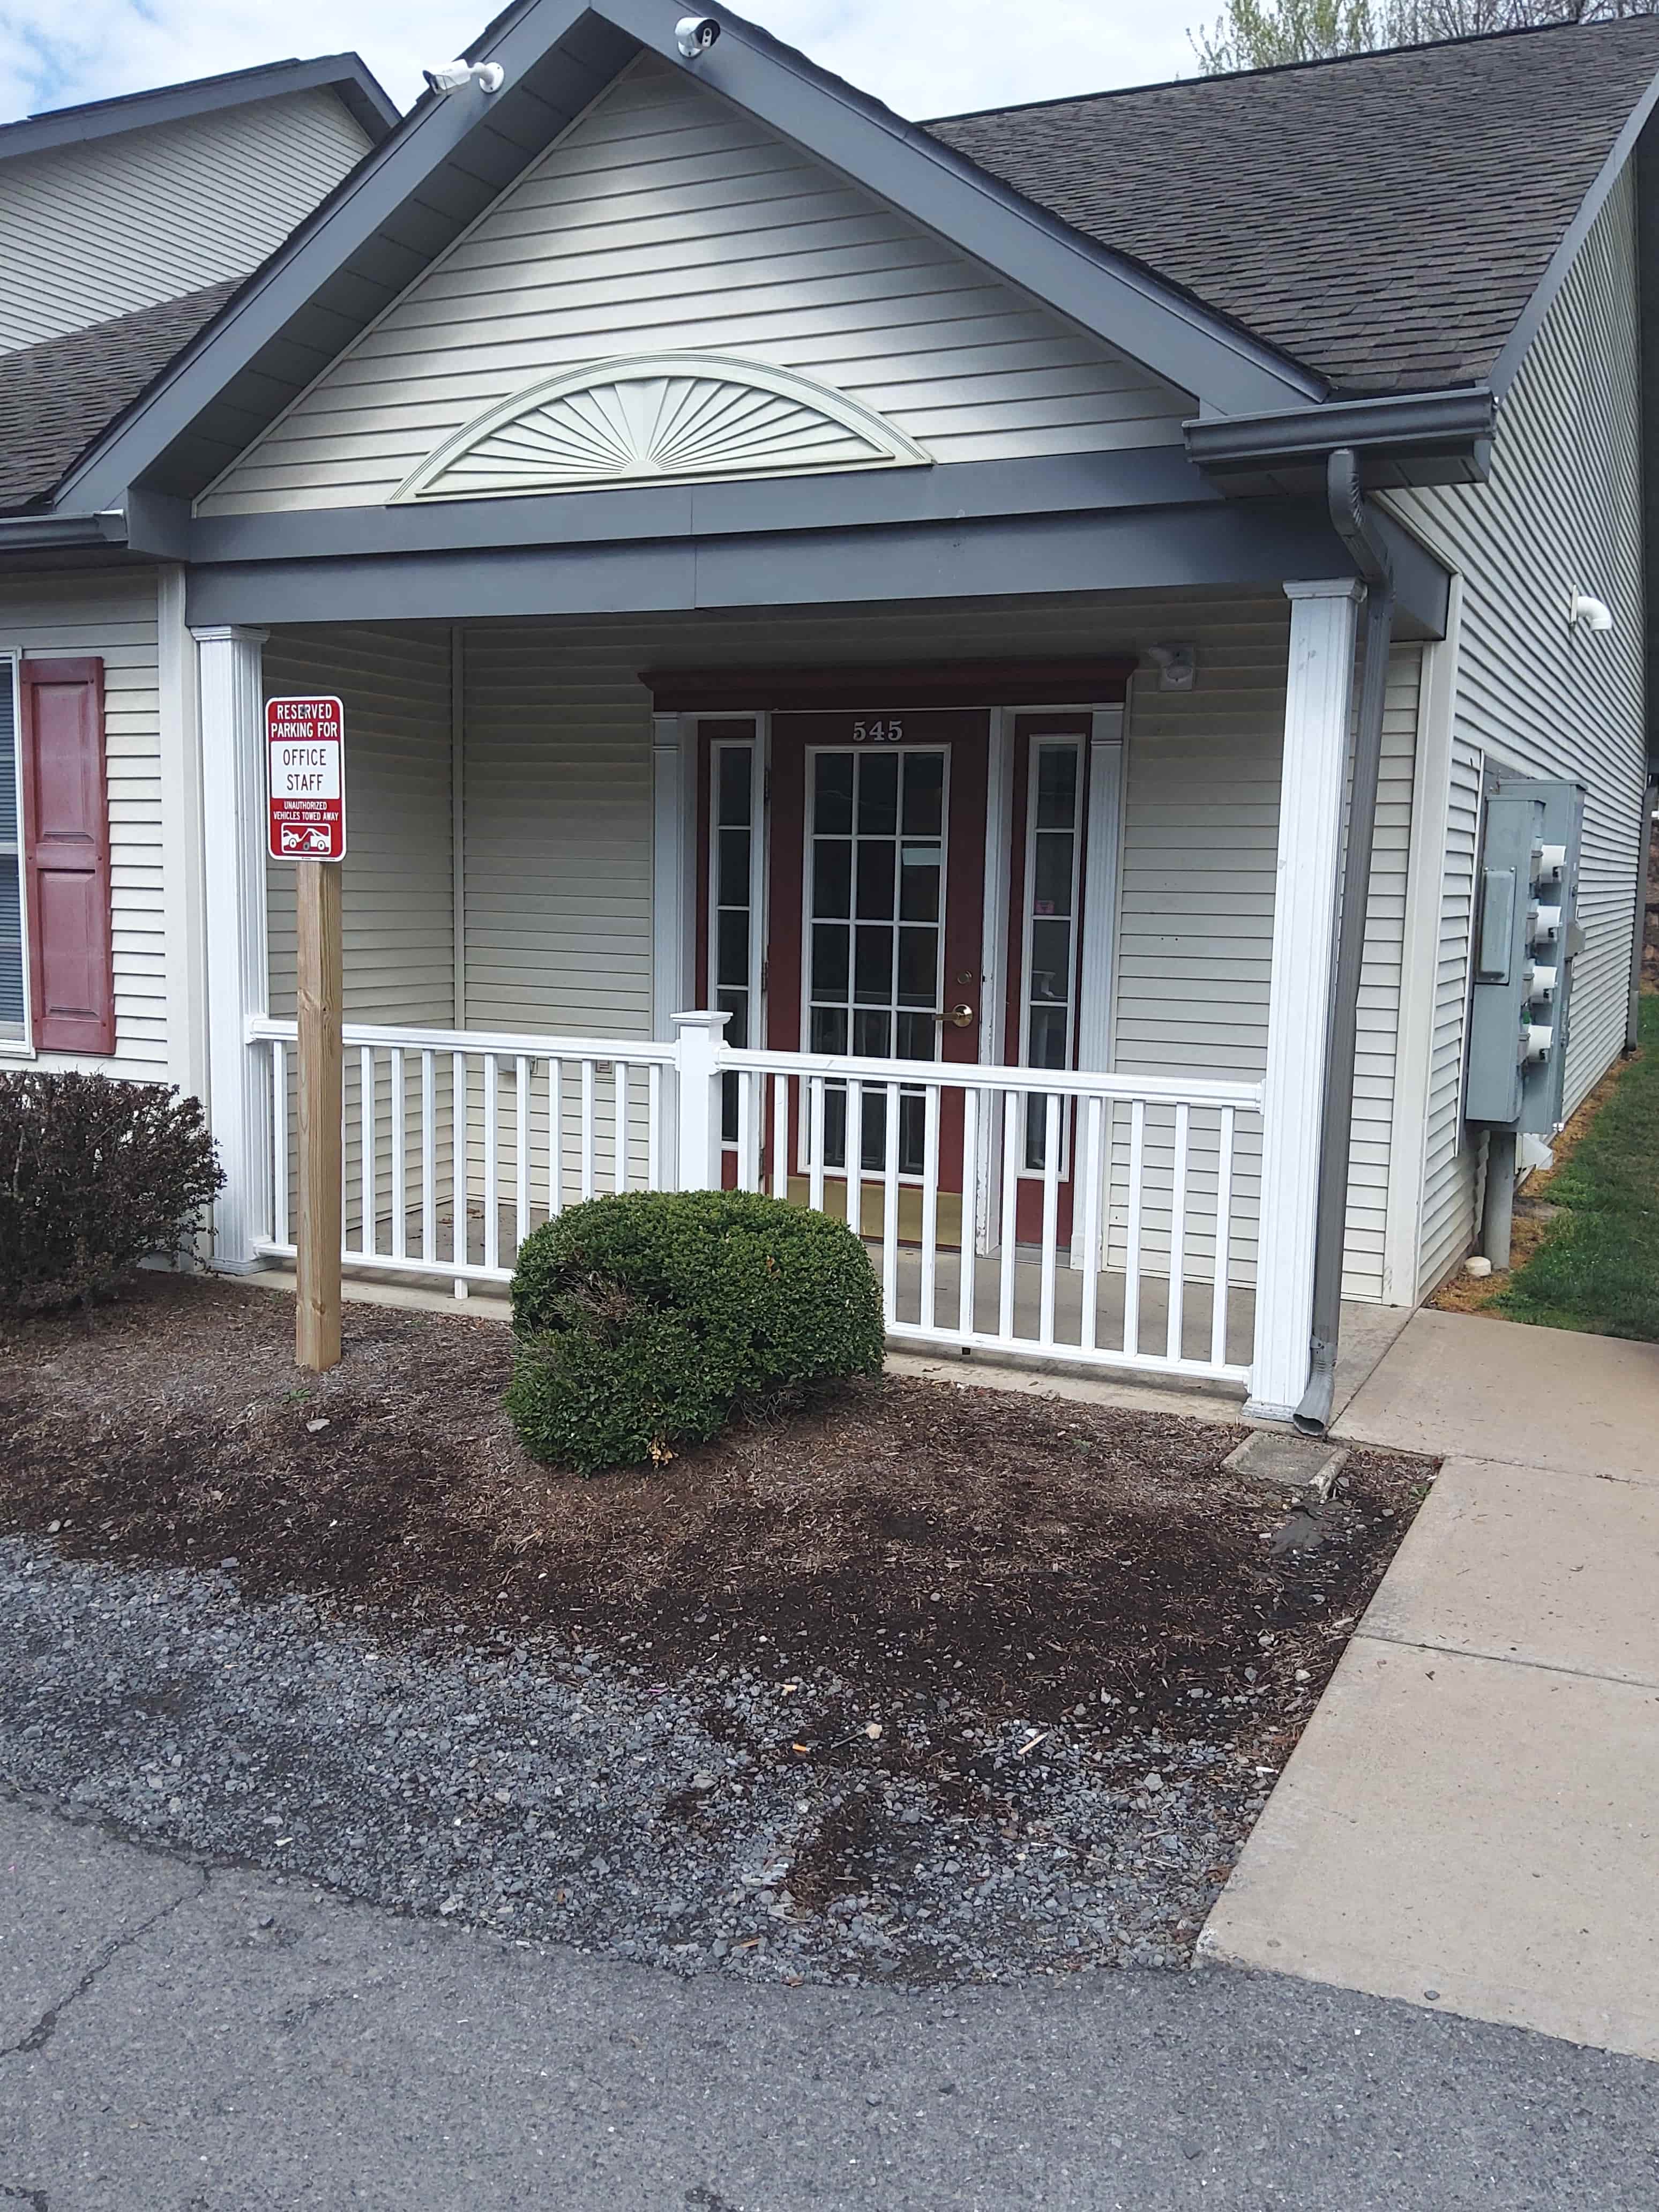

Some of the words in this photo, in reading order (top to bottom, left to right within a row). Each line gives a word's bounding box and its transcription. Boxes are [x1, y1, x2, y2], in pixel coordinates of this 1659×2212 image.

[277, 703, 332, 720] RESERVED
[271, 722, 313, 738] PARKING
[318, 722, 338, 737] FOR
[853, 721, 902, 741] 545
[283, 749, 326, 766] OFFICE
[287, 774, 323, 791] STAFF
[284, 801, 327, 810] UNAUTHORIZED
[273, 811, 300, 820] VEHICLES
[302, 812, 321, 820] TOWED
[323, 812, 339, 821] AWAY
